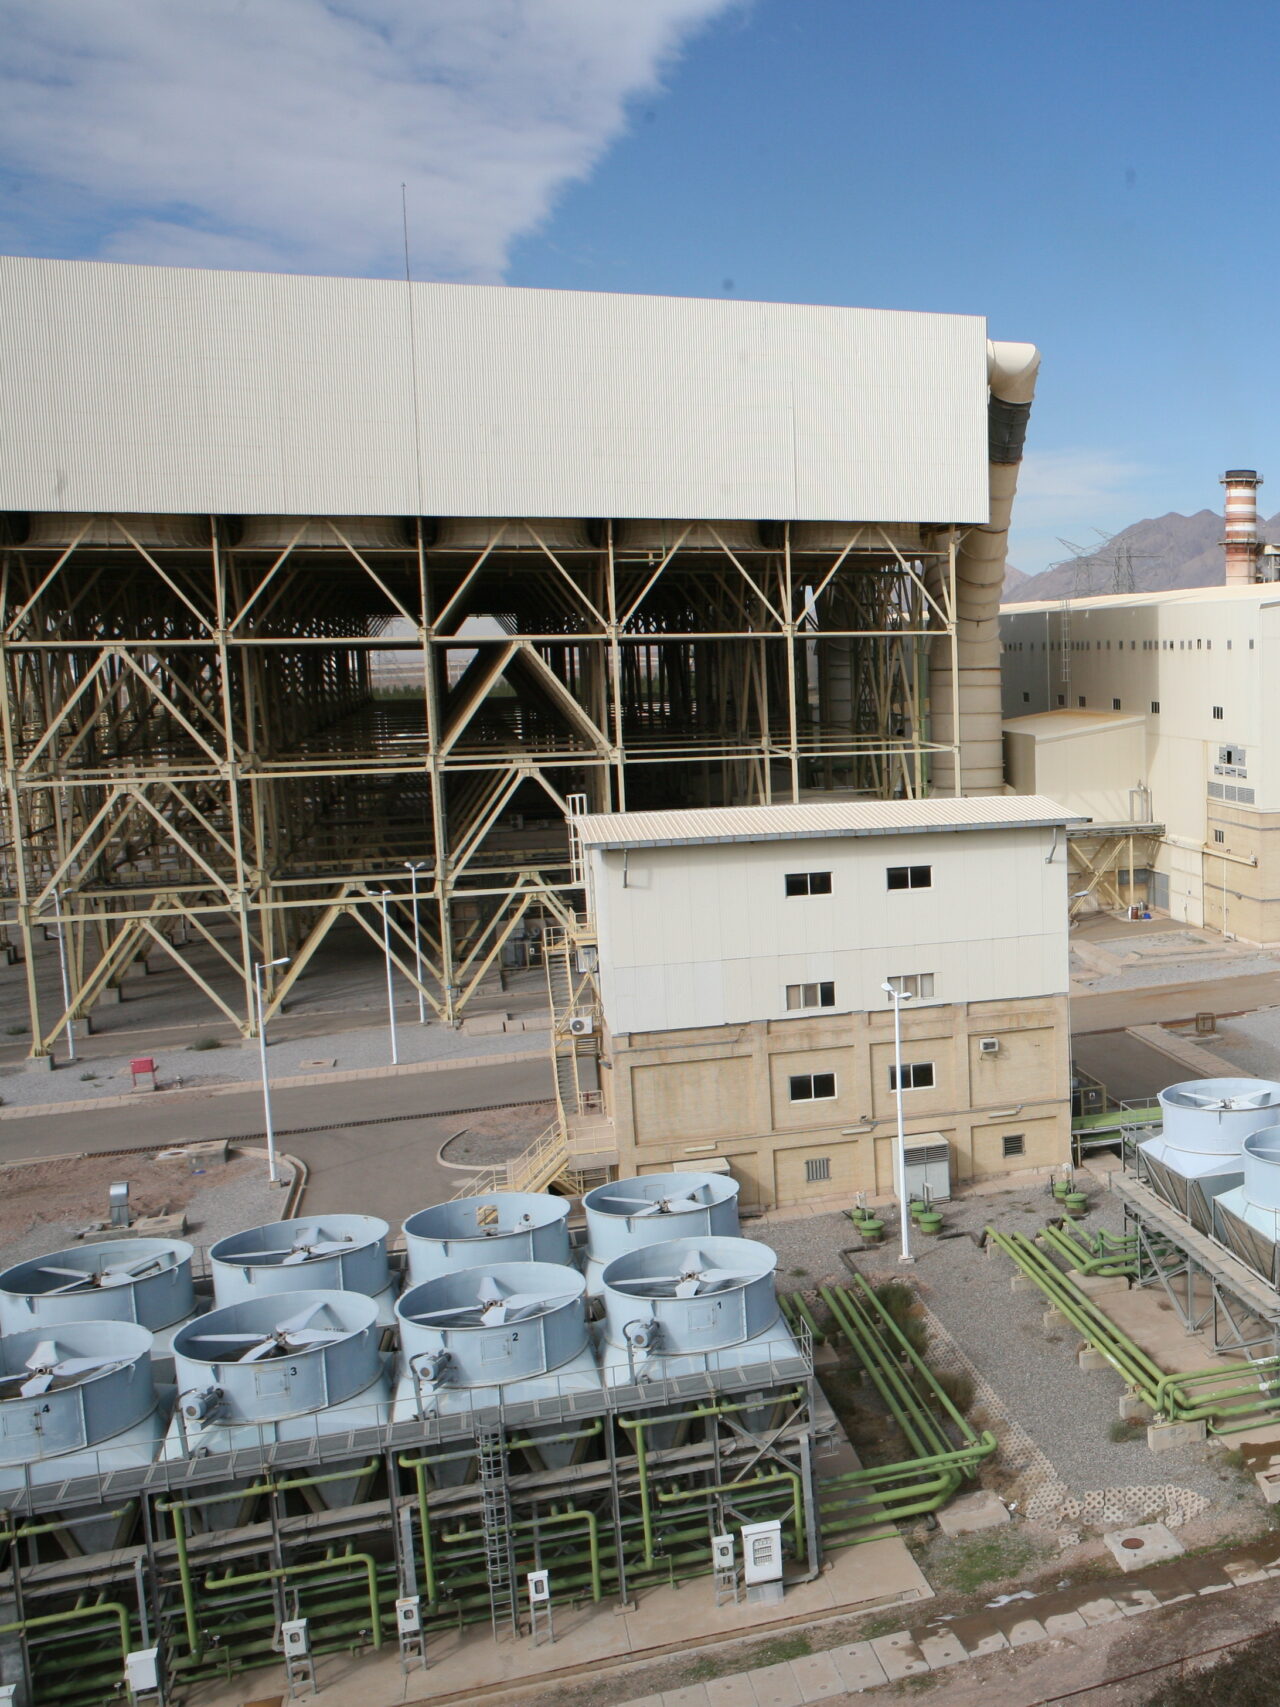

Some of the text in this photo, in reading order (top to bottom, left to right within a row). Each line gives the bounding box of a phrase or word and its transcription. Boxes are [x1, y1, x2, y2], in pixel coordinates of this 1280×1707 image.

[716, 1301, 722, 1310] 1
[512, 1332, 519, 1342] 2
[290, 1366, 298, 1377] 3
[42, 1404, 50, 1413] 4
